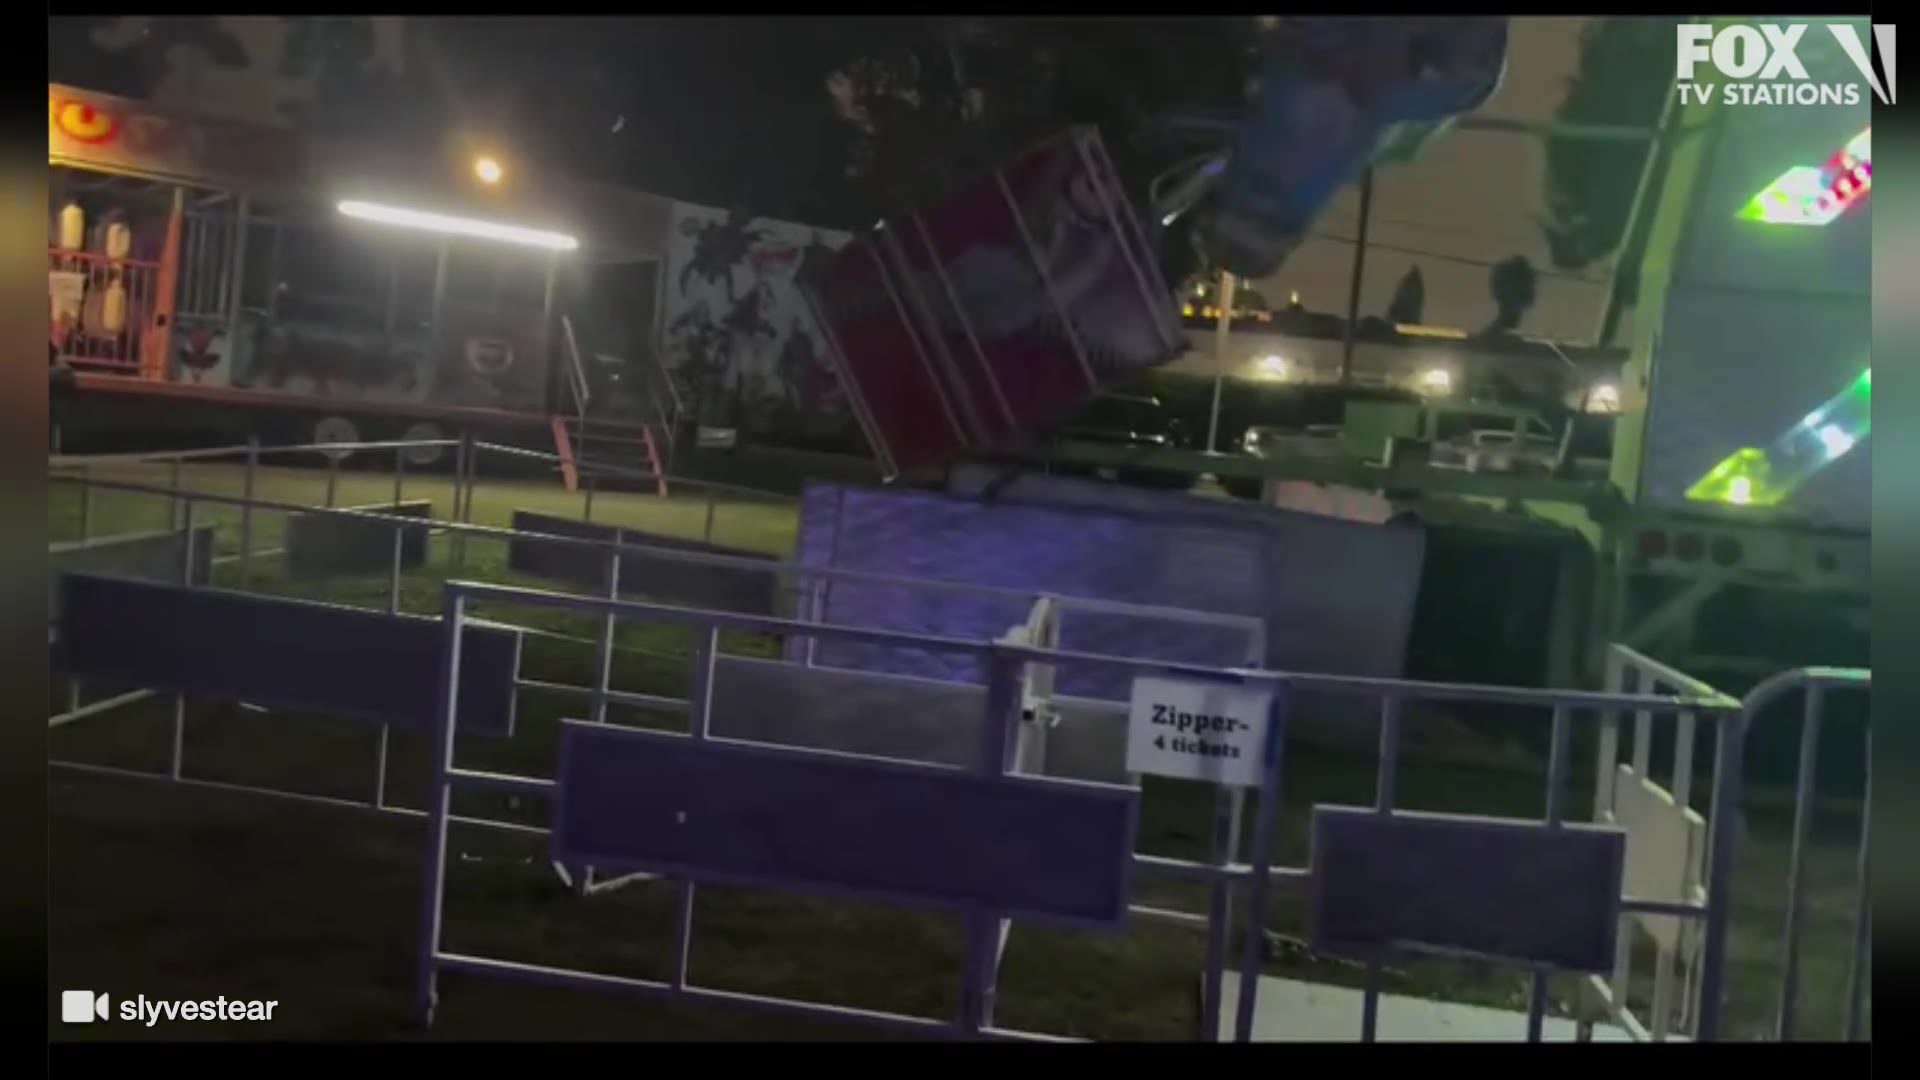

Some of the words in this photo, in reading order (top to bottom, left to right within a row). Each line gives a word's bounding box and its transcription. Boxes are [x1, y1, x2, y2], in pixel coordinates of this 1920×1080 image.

[1152, 703, 1249, 733] Zipper-
[1154, 735, 1165, 750] 4
[1171, 737, 1240, 758] tickets
